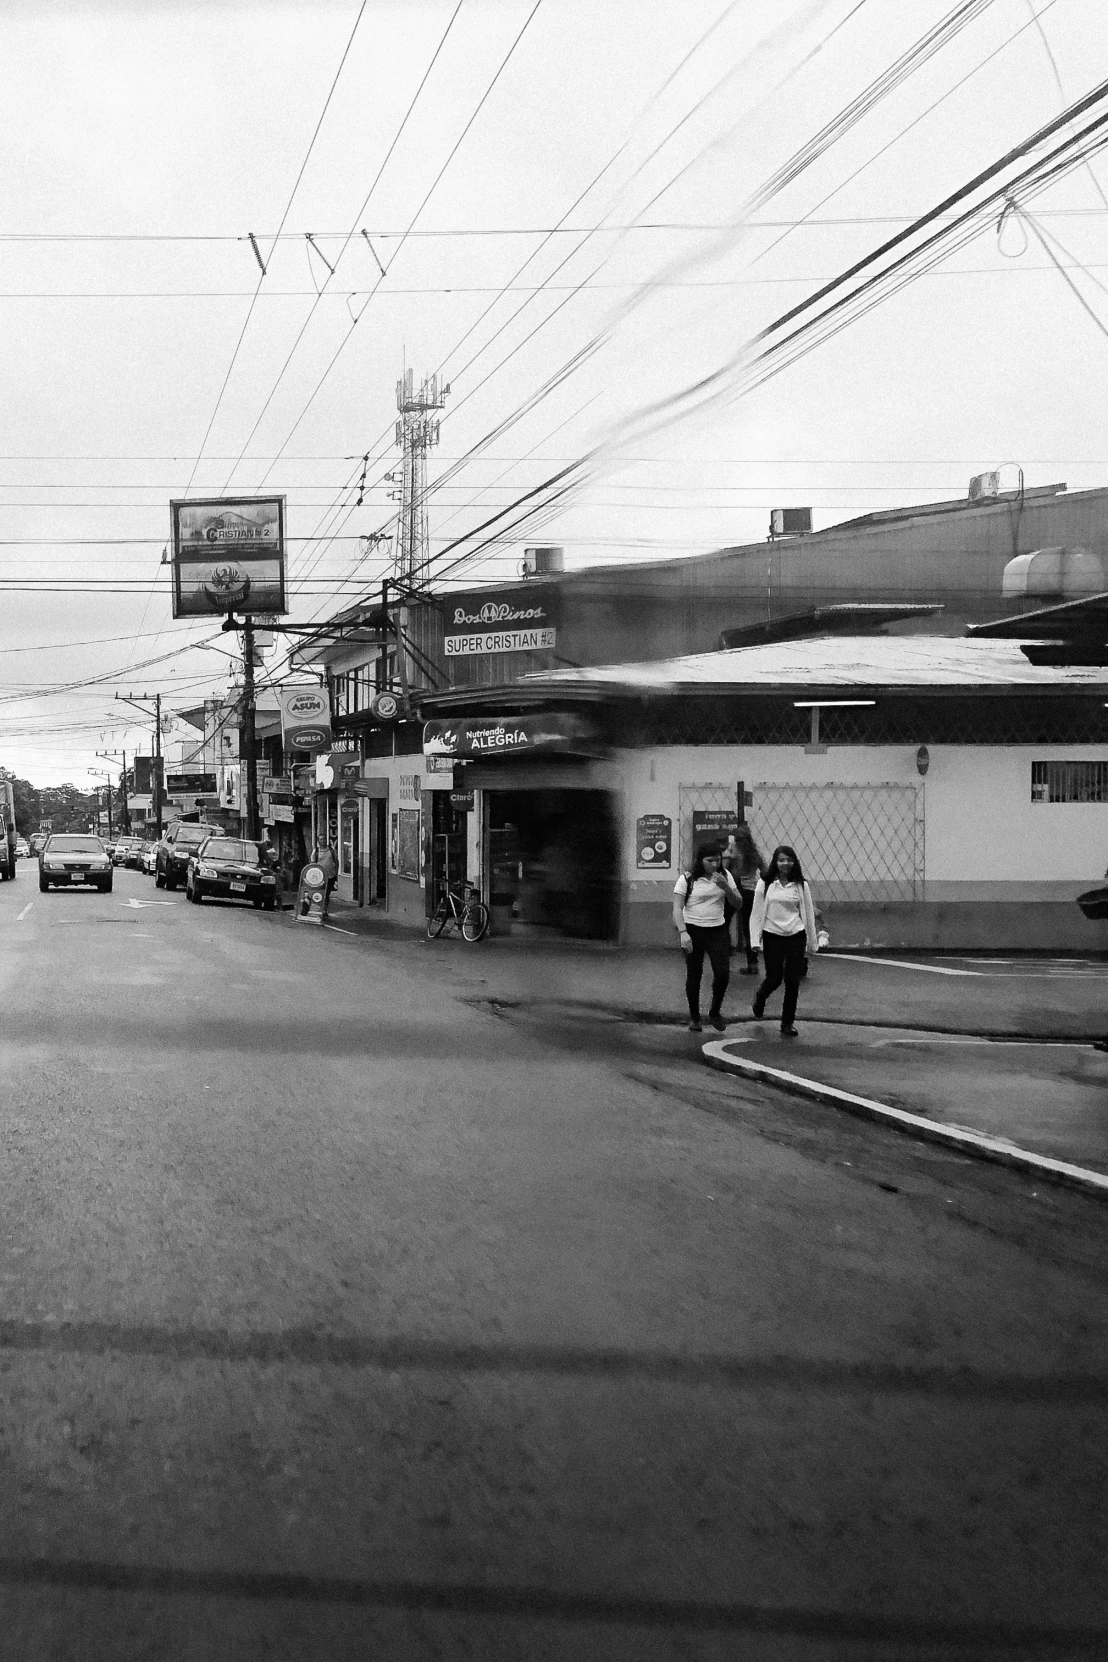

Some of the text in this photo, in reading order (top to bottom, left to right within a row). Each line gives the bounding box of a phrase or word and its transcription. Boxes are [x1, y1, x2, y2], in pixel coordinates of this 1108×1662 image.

[207, 528, 254, 542] CRISTIAN
[453, 604, 547, 625] Dos Pinos
[447, 631, 554, 654] SUPER CRISTIAN #2
[292, 701, 321, 711] ASUN
[466, 727, 505, 739] Nutriendo
[471, 730, 529, 750] ALEGRÍA
[450, 793, 473, 802] Claro
